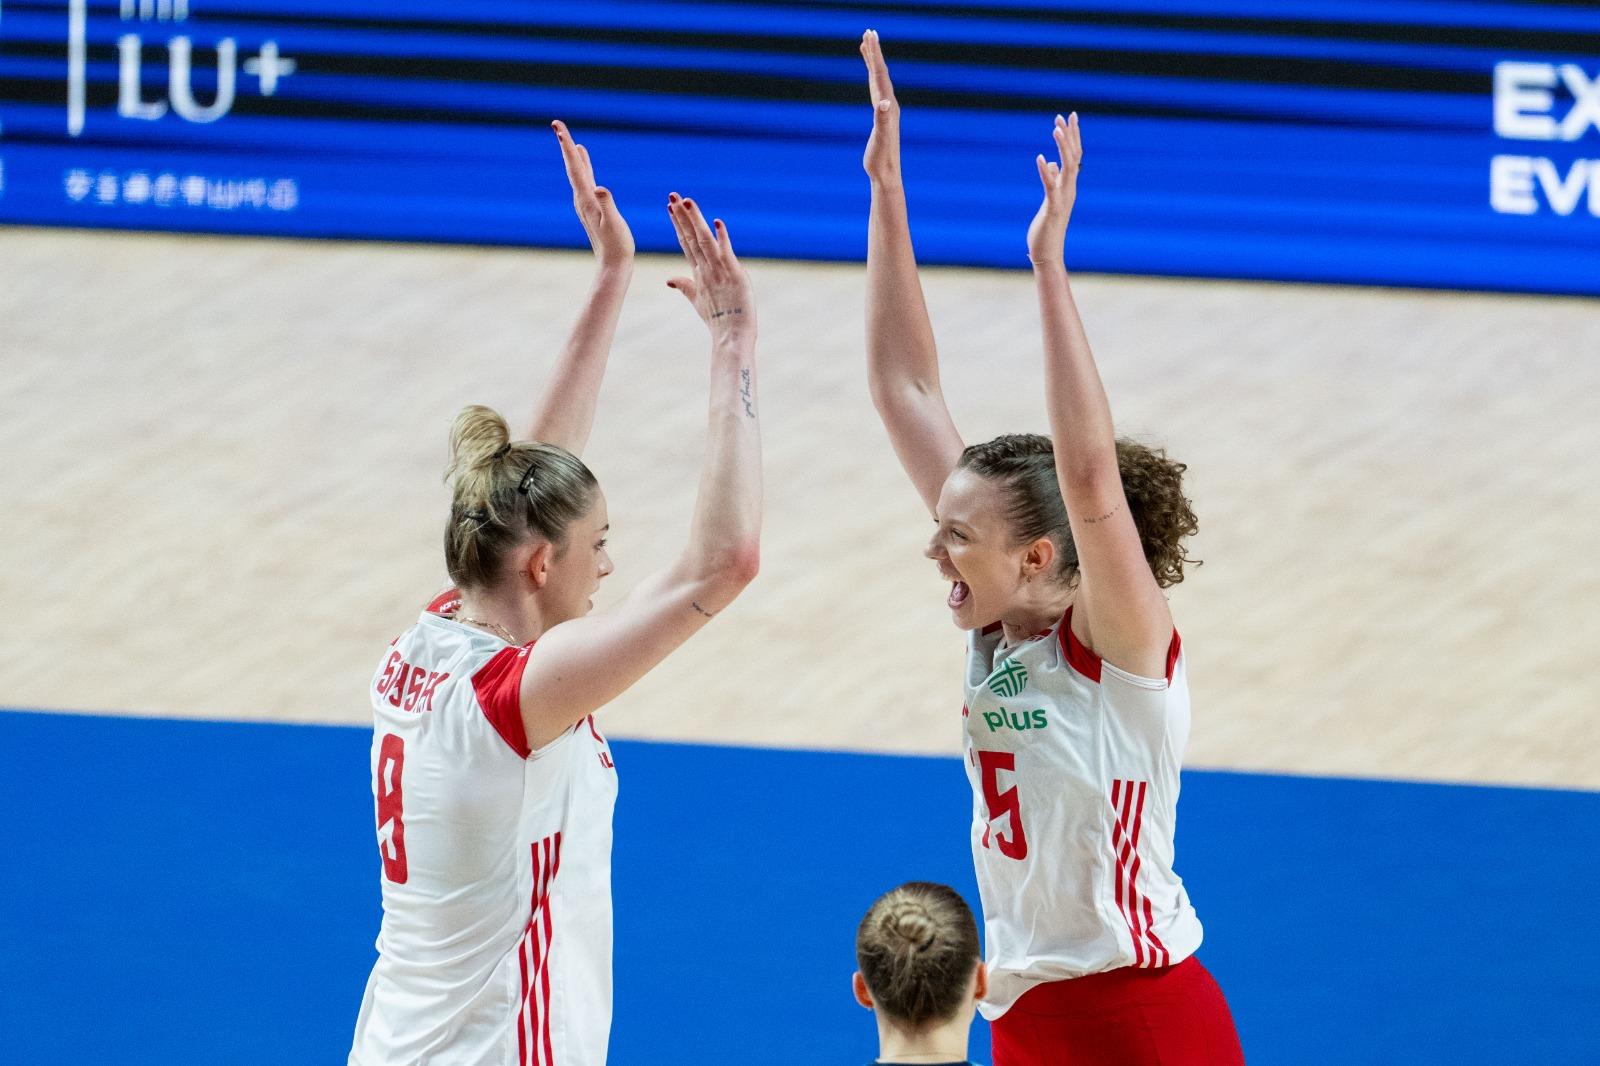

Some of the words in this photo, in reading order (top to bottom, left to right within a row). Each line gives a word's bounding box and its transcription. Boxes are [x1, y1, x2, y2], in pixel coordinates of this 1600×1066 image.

[1490, 154, 1600, 217] EV
[982, 706, 1048, 732] plus
[377, 733, 408, 885] 9
[970, 748, 1028, 861] 5
